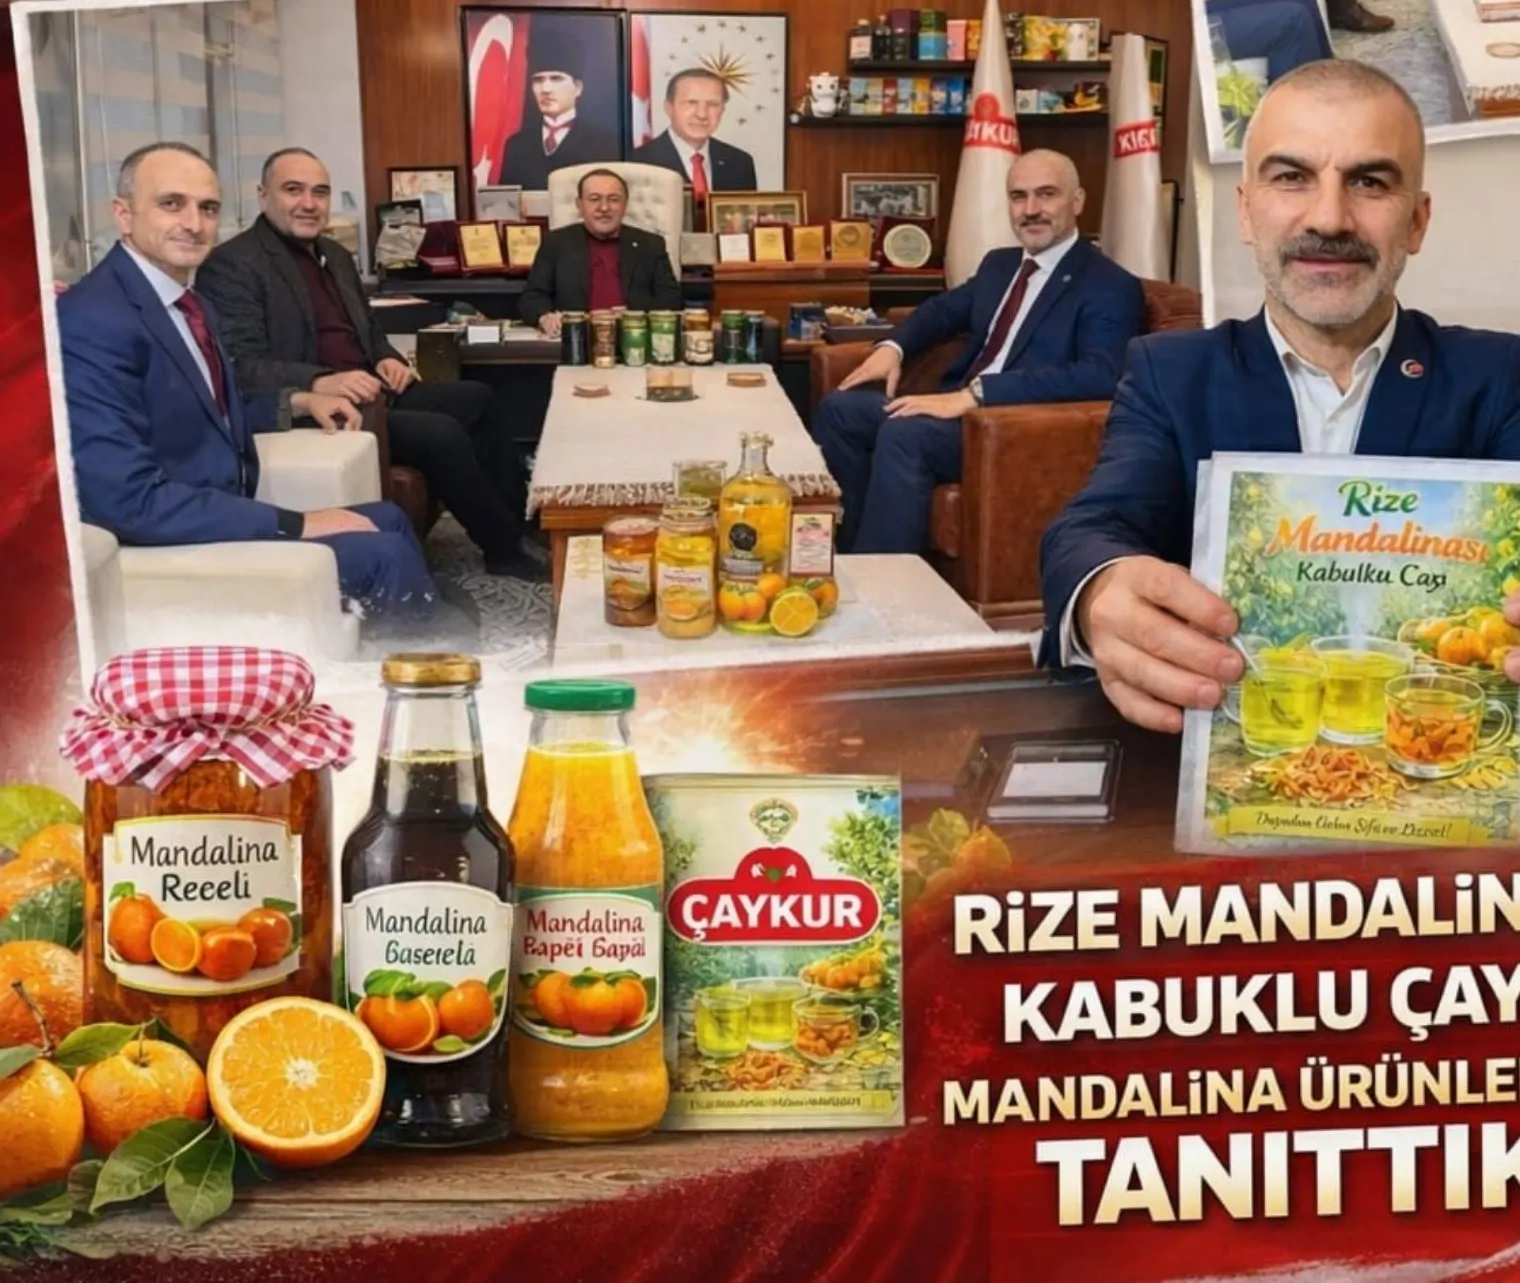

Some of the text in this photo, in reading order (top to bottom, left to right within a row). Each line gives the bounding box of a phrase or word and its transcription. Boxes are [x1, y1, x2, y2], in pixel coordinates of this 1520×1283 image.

[1338, 480, 1419, 517] Rize
[131, 835, 279, 867] Mandalina
[366, 906, 487, 934] Mandalina
[526, 908, 645, 934] Mandalina
[682, 893, 863, 941] ÇAYKUR
